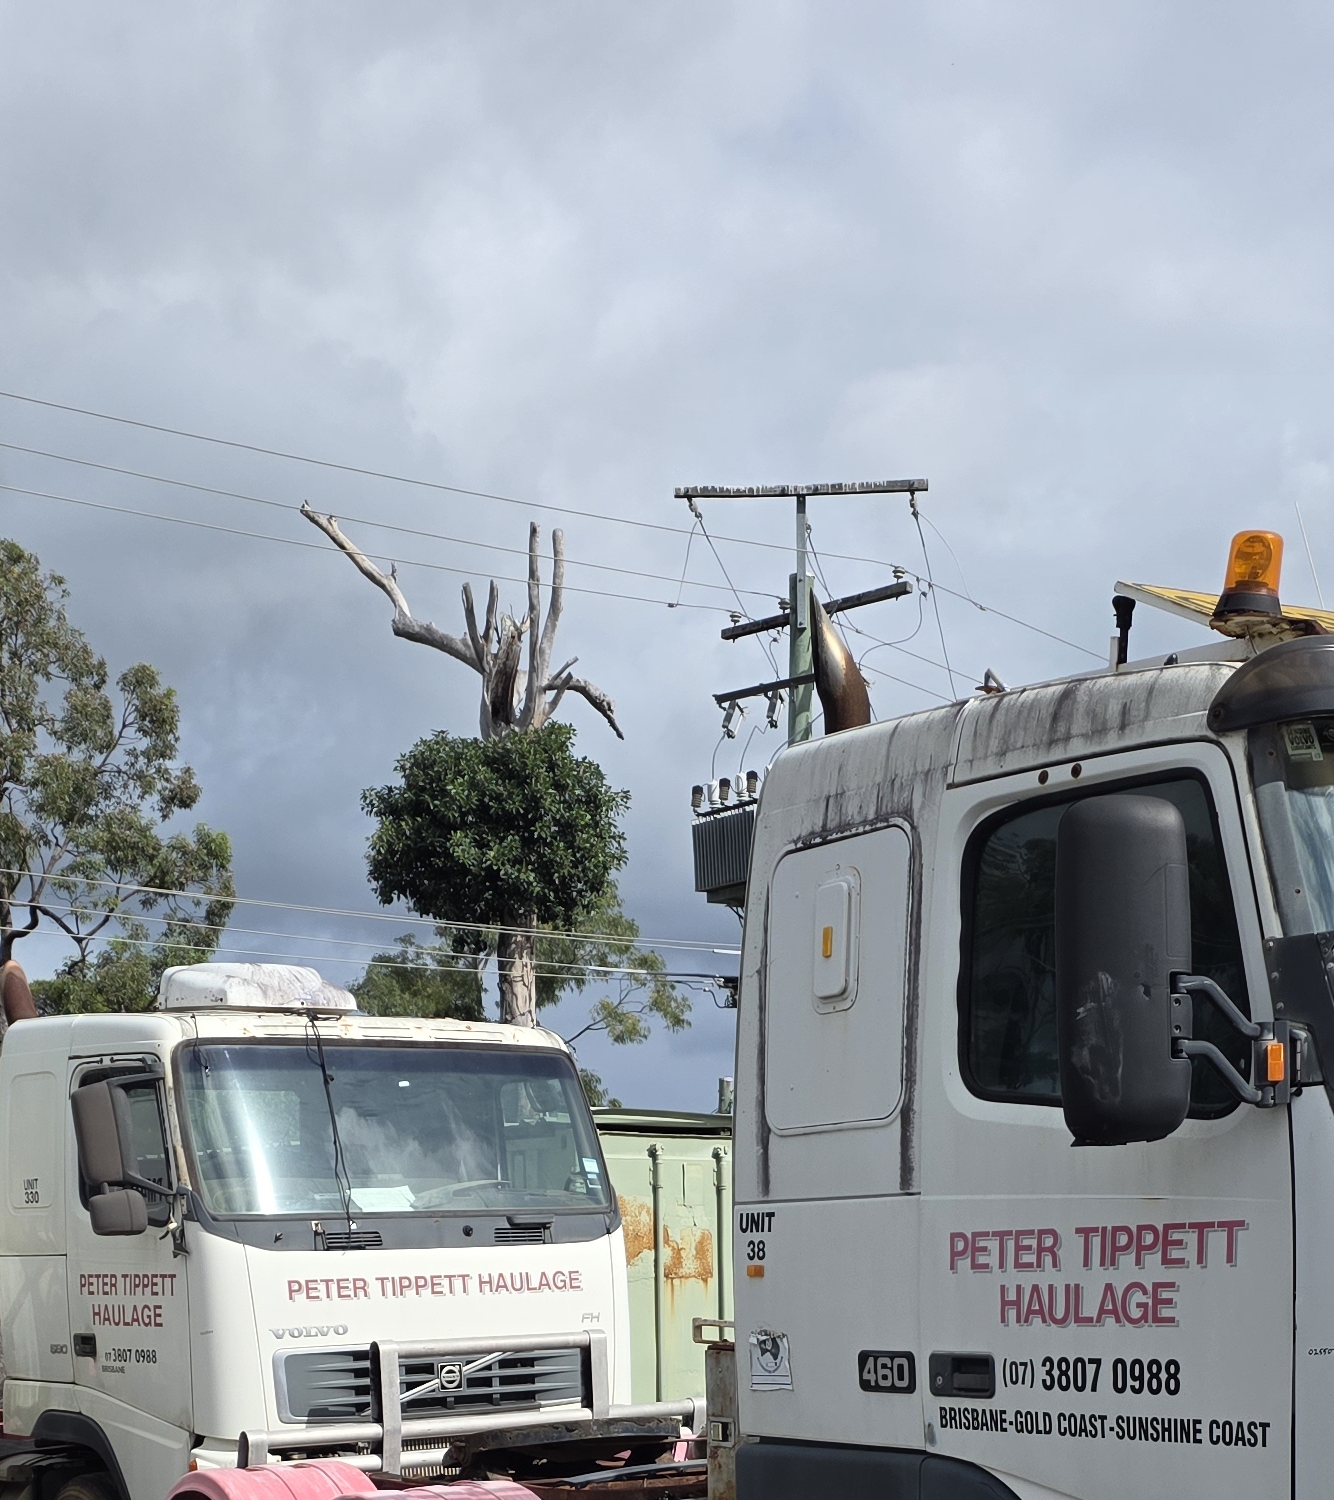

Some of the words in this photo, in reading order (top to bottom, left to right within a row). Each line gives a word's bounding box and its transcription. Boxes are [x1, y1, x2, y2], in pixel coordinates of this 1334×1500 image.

[1288, 733, 1315, 746] VOLVO
[23, 1178, 39, 1190] UNIT
[24, 1191, 40, 1204] 330
[739, 1211, 776, 1234] UNIT
[747, 1239, 766, 1261] 38
[949, 1228, 1062, 1274] PETER
[1075, 1220, 1249, 1270] TIPPETT
[79, 1273, 118, 1296] PETER
[121, 1273, 177, 1297] TIPPETT
[287, 1277, 370, 1302] PETER
[375, 1273, 472, 1299] TIPPETT
[478, 1270, 583, 1295] HAULAGE
[92, 1303, 164, 1328] HAULAGE
[1000, 1281, 1180, 1328] HAULAGE
[581, 1312, 601, 1324] FH
[269, 1323, 349, 1340] VOLVO
[104, 1352, 112, 1362] 07
[112, 1348, 132, 1363] 3807
[134, 1349, 157, 1364] 0988
[101, 1365, 126, 1374] BRISBANE
[862, 1356, 909, 1388] 460
[1002, 1357, 1035, 1388] (07)
[1041, 1356, 1102, 1392] 3807
[1112, 1357, 1181, 1396] 0988
[939, 1406, 1052, 1435] BRISBANE-GOLD
[1057, 1412, 1203, 1444] COAST-SUNSHINE
[1208, 1419, 1271, 1448] COAST
